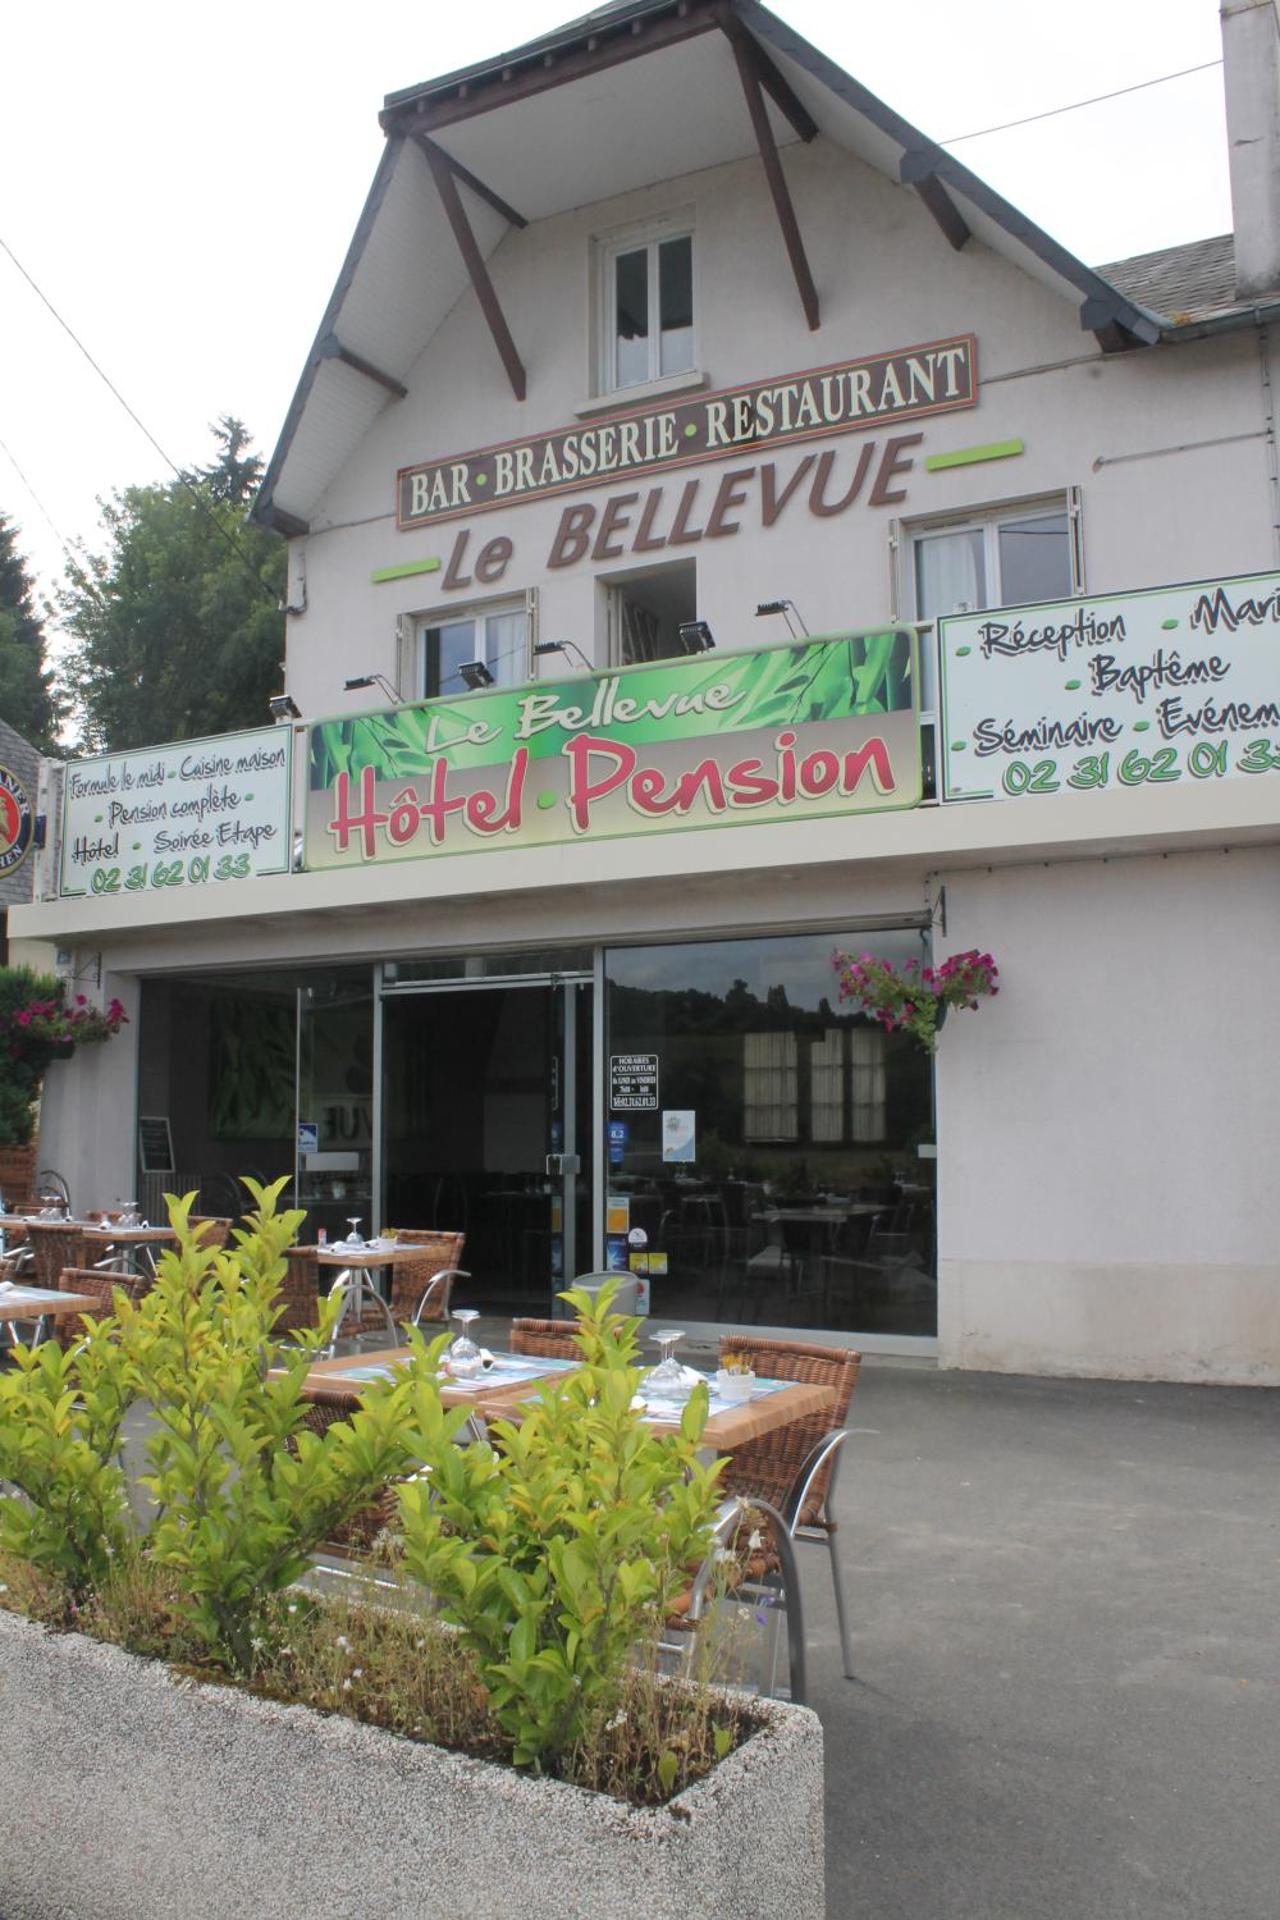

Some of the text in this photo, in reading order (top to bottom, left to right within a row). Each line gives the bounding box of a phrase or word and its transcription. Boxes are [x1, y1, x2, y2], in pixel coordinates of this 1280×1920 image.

[410, 347, 968, 516] BAR BRASSERIE RESTAURANT
[440, 431, 923, 590] Le BELLEVUE
[978, 608, 1127, 661] Réception
[1089, 649, 1231, 703] Baptême
[425, 676, 747, 754] Le Bellevue
[973, 712, 1123, 756] Séminaire
[70, 747, 285, 797] Formule le midi Cuisine maison
[1003, 759, 1060, 795] 02
[1067, 752, 1109, 788] 31
[1117, 748, 1182, 785] 62
[1188, 740, 1229, 777] 01
[108, 785, 241, 829] Pension complète
[328, 731, 898, 859] Hôtel Pension
[72, 821, 277, 864] Hôtel Soirée Etape
[90, 853, 250, 894] 02 31 62 01 33
